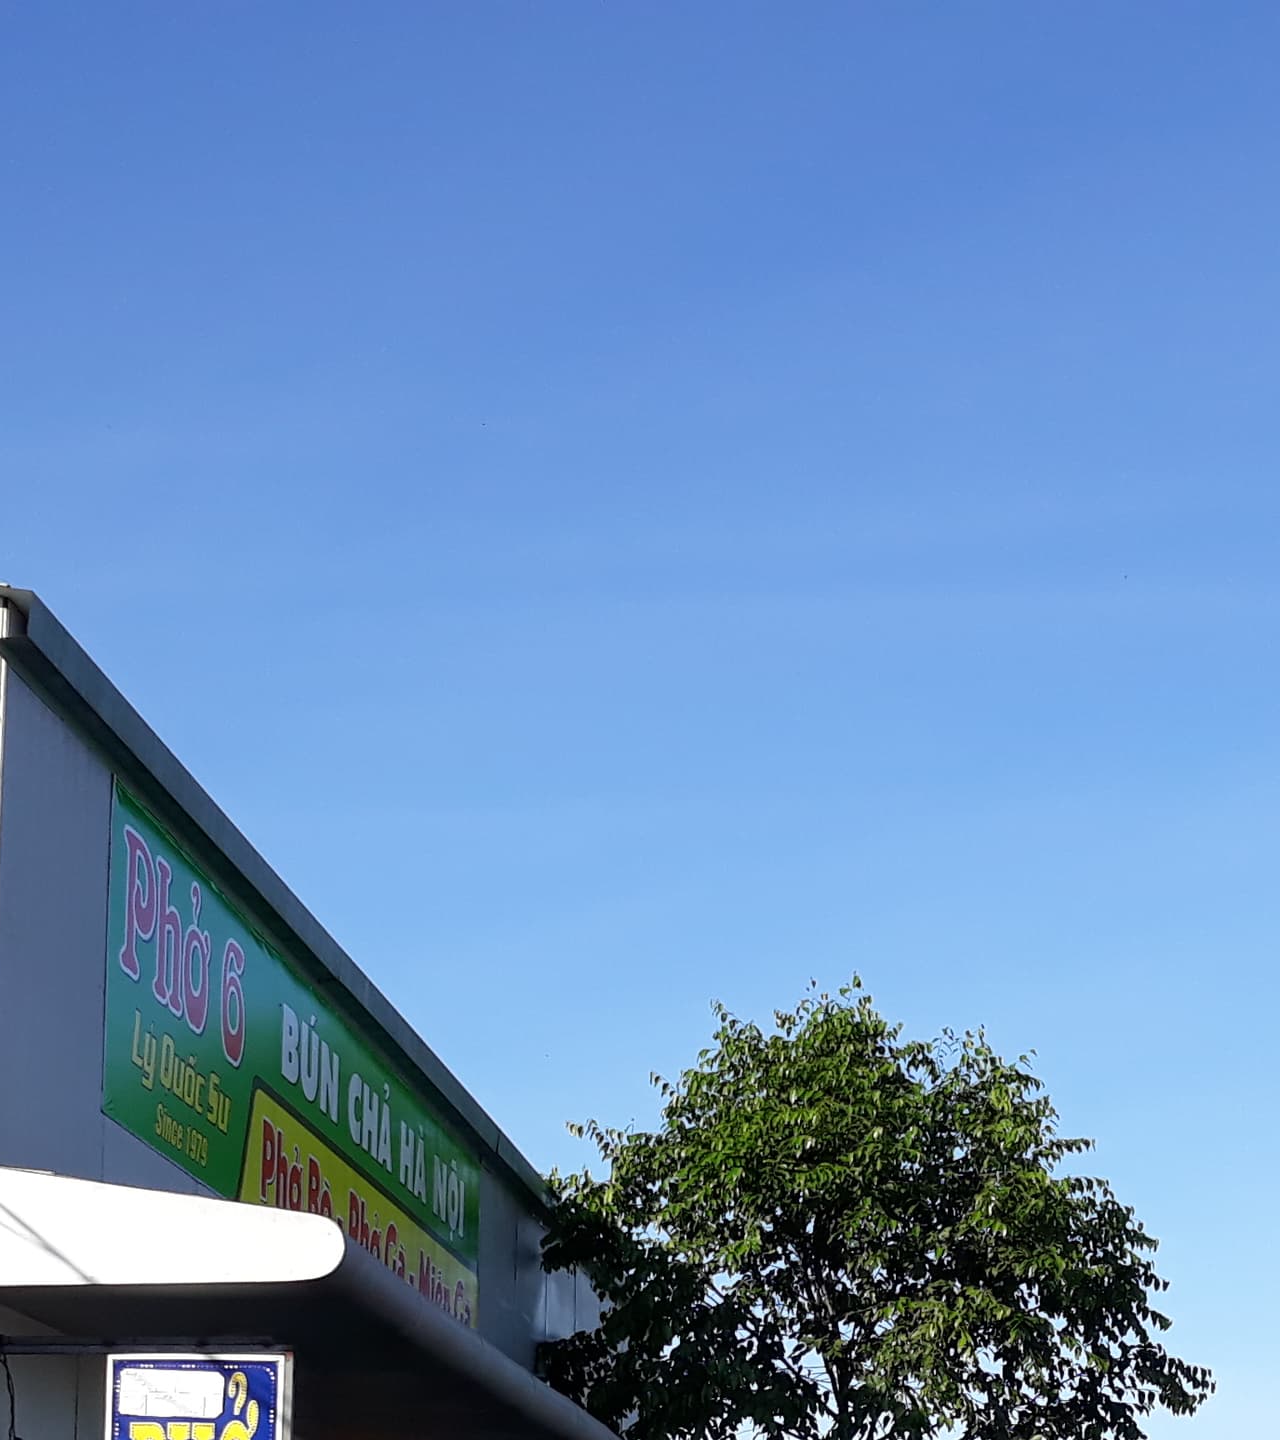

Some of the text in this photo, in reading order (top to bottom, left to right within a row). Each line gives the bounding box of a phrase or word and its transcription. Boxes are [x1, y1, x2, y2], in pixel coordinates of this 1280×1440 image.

[119, 824, 245, 1068] Phở 6
[160, 1032, 206, 1114] Quốc
[155, 1102, 209, 1168] Since 1979
[260, 1116, 304, 1211] Phở
[281, 1002, 465, 1240] BÚN CHẢ HÀ NỘI
